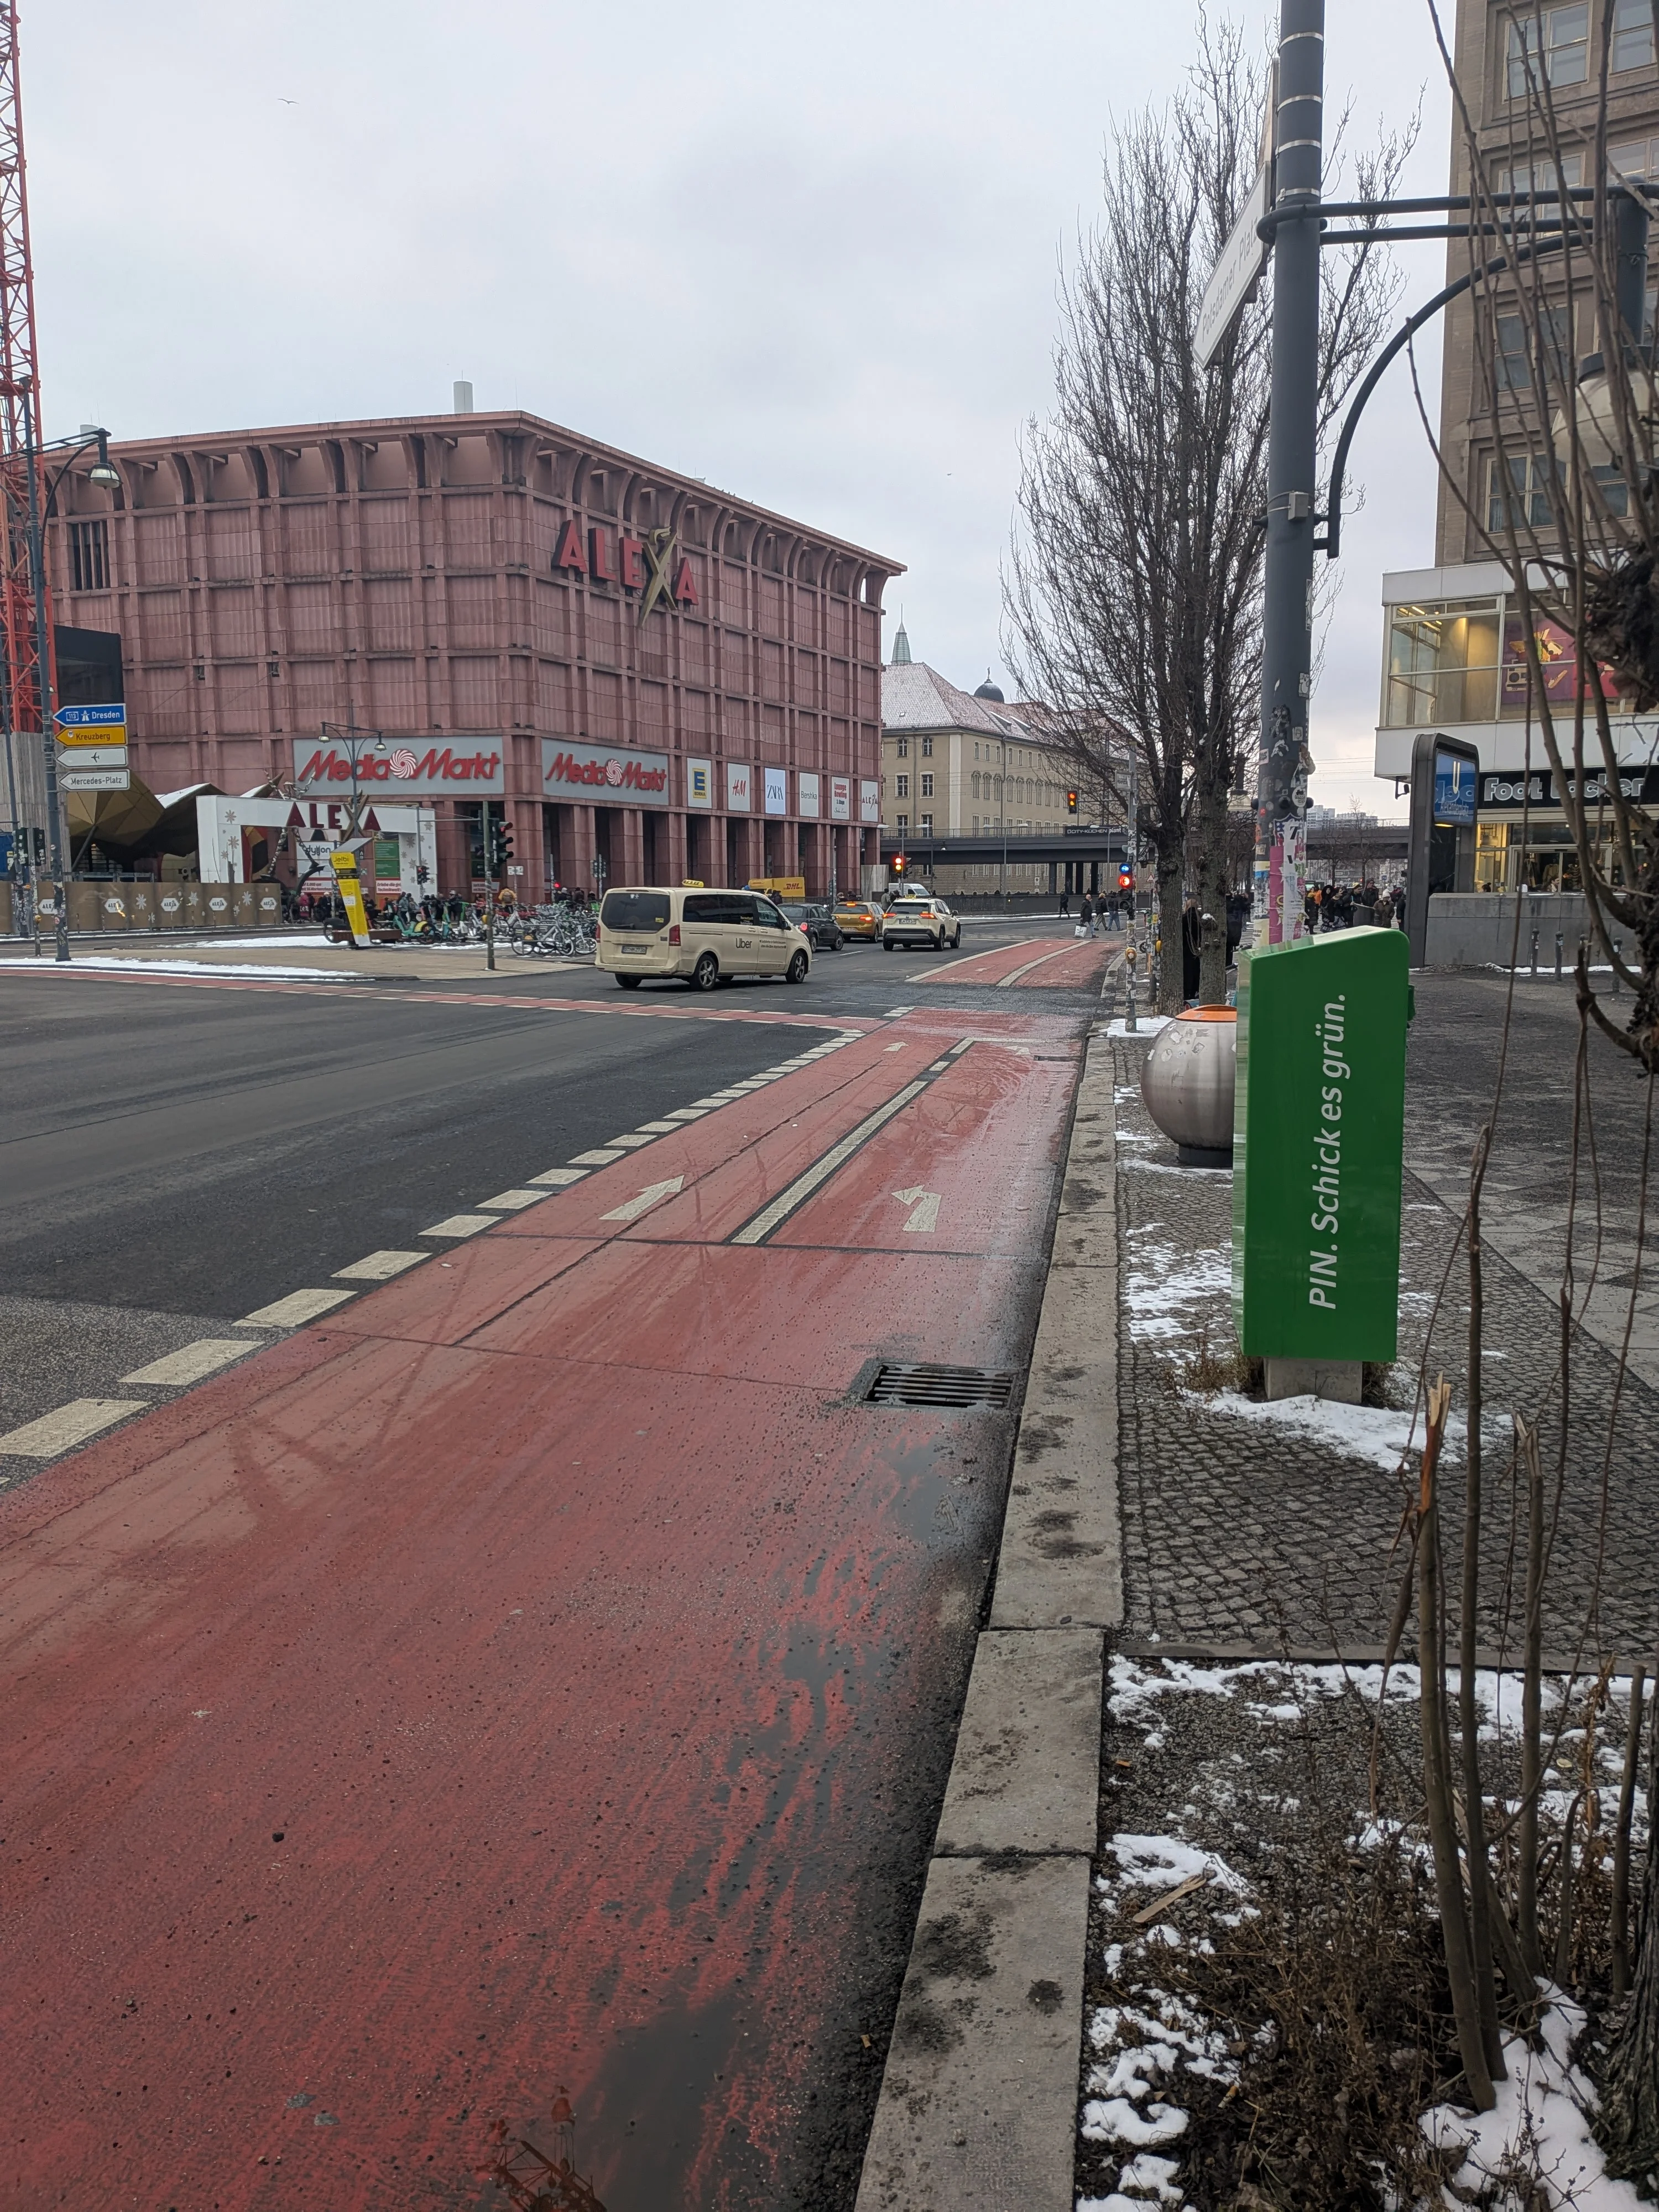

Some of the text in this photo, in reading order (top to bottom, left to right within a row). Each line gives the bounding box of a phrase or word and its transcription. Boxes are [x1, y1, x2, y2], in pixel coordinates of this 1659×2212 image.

[1202, 216, 1258, 343] Potsdamer Platz
[551, 520, 699, 627] ALEXA
[91, 711, 121, 719] Dresden
[76, 733, 111, 742] Kreuzberg
[298, 748, 500, 781] Media Markt
[545, 753, 667, 791] Media Markt
[70, 776, 122, 785] Mercedes-Platz
[732, 779, 747, 797] H&M
[834, 782, 847, 791] Lounge
[1484, 777, 1543, 801] Foot
[767, 785, 784, 800] ZARA
[801, 791, 817, 800] Bershka
[834, 790, 847, 799] Bowling
[862, 793, 878, 810] ALEXA
[286, 795, 382, 841] ALEXA
[735, 937, 753, 949] Uber
[1309, 994, 1351, 1310] PIN. Schick es grün.
